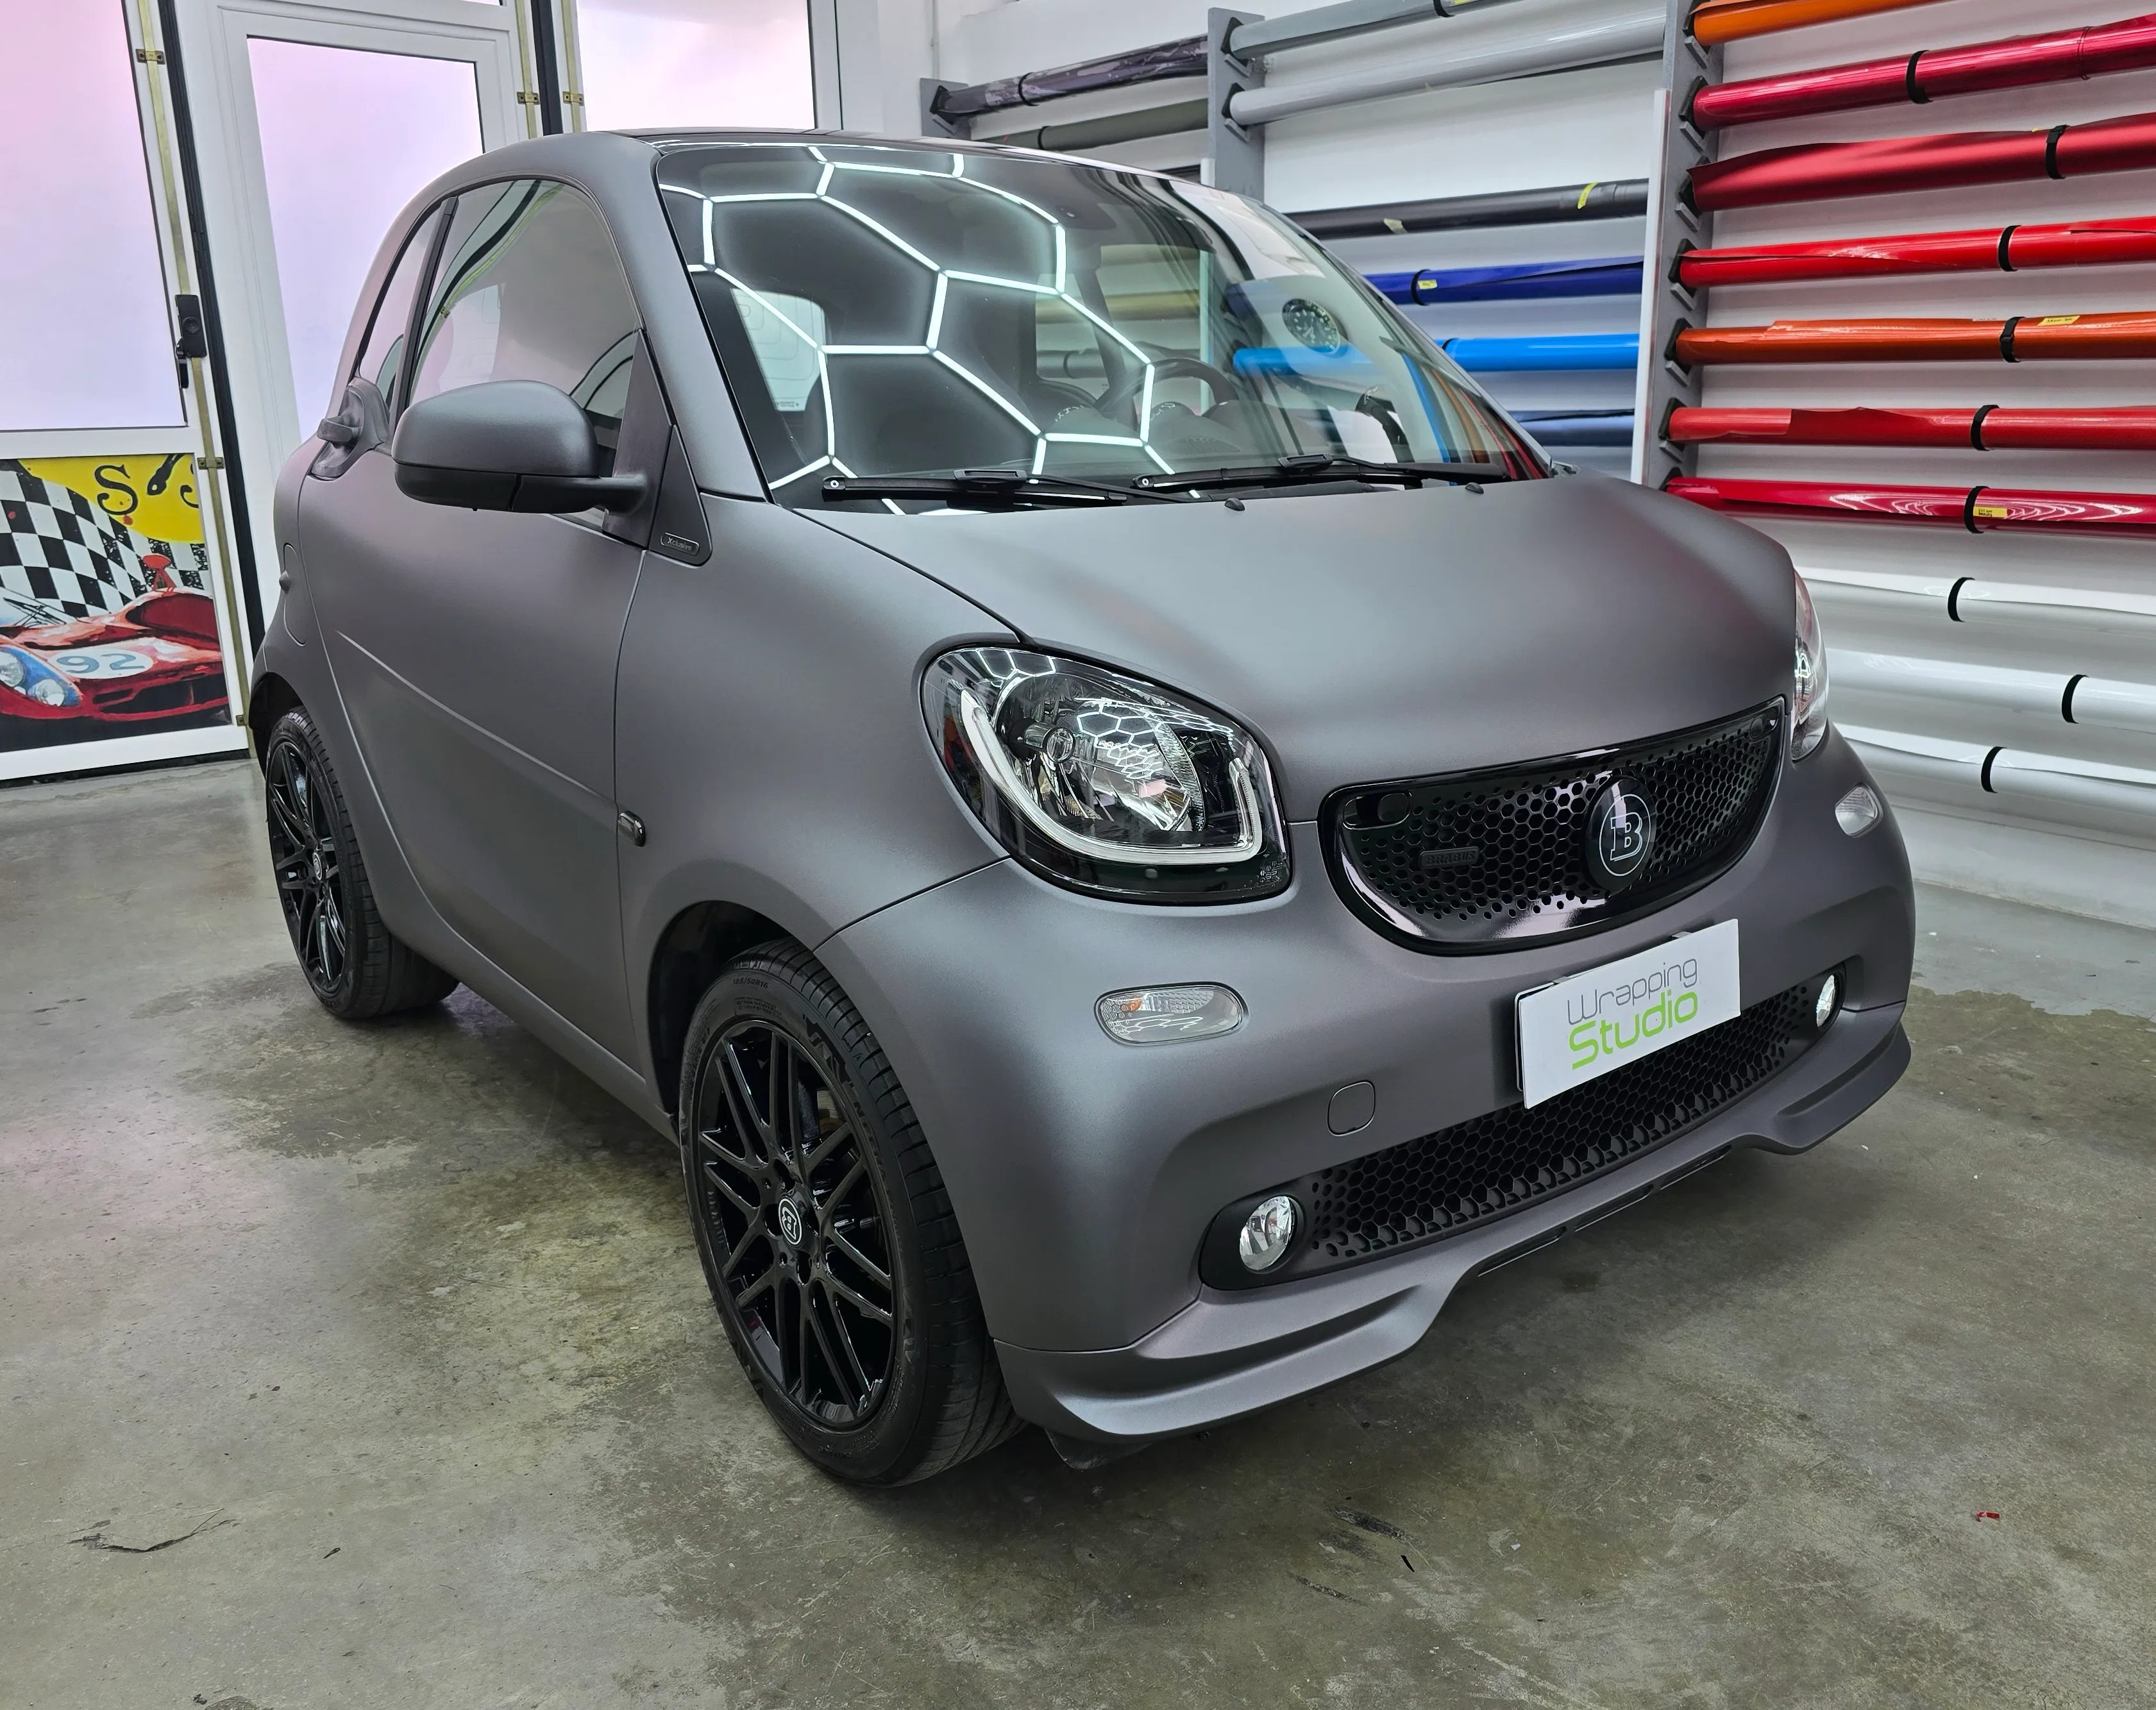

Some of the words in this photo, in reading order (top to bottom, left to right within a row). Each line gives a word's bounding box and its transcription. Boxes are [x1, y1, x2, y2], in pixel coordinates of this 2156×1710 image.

[668, 537, 693, 551] Xclusive
[56, 653, 145, 673] 92
[1610, 812, 1643, 861] B
[1425, 851, 1475, 865] BRABUS
[733, 977, 769, 989] 185/50R16
[1567, 958, 1697, 1025] Wrapping
[1569, 989, 1698, 1070] Studio
